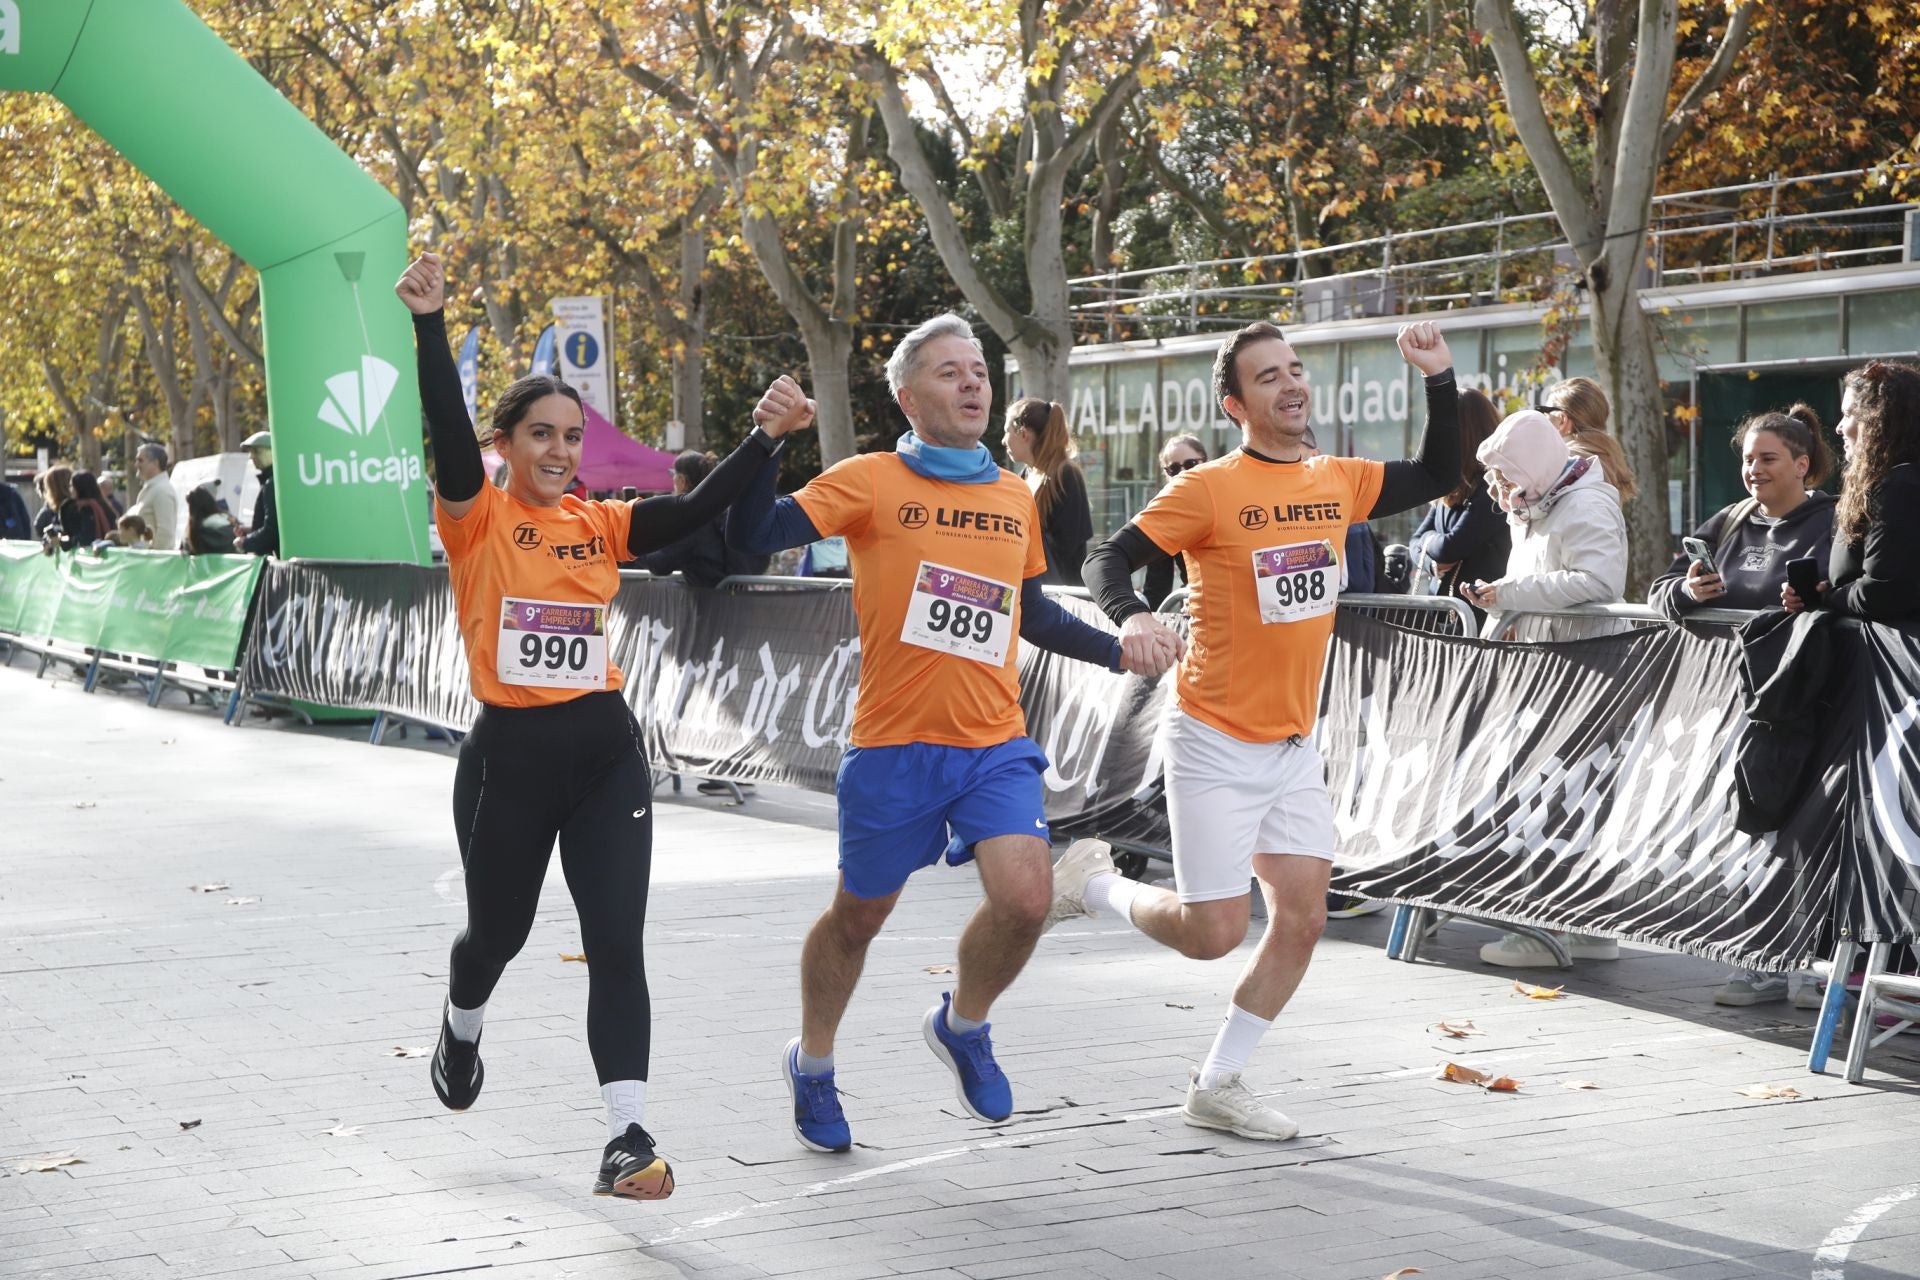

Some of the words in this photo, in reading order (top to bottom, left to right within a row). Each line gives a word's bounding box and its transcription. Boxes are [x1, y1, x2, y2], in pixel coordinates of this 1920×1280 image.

[1070, 377, 1233, 437] VALLADOL
[298, 447, 421, 490] Unicaja
[936, 507, 1023, 538] LIFETEC
[1273, 503, 1342, 522] LIFETEC
[1286, 554, 1317, 566] EMPRESAS
[953, 585, 989, 600] EMPRESAS
[955, 576, 981, 590] CARRERA
[1275, 570, 1325, 607] 988
[540, 616, 581, 626] EMPRESAS
[541, 607, 573, 618] CARRERA
[573, 610, 582, 618] DE
[927, 599, 993, 644] 989
[519, 633, 588, 671] 990
[740, 641, 800, 744] de
